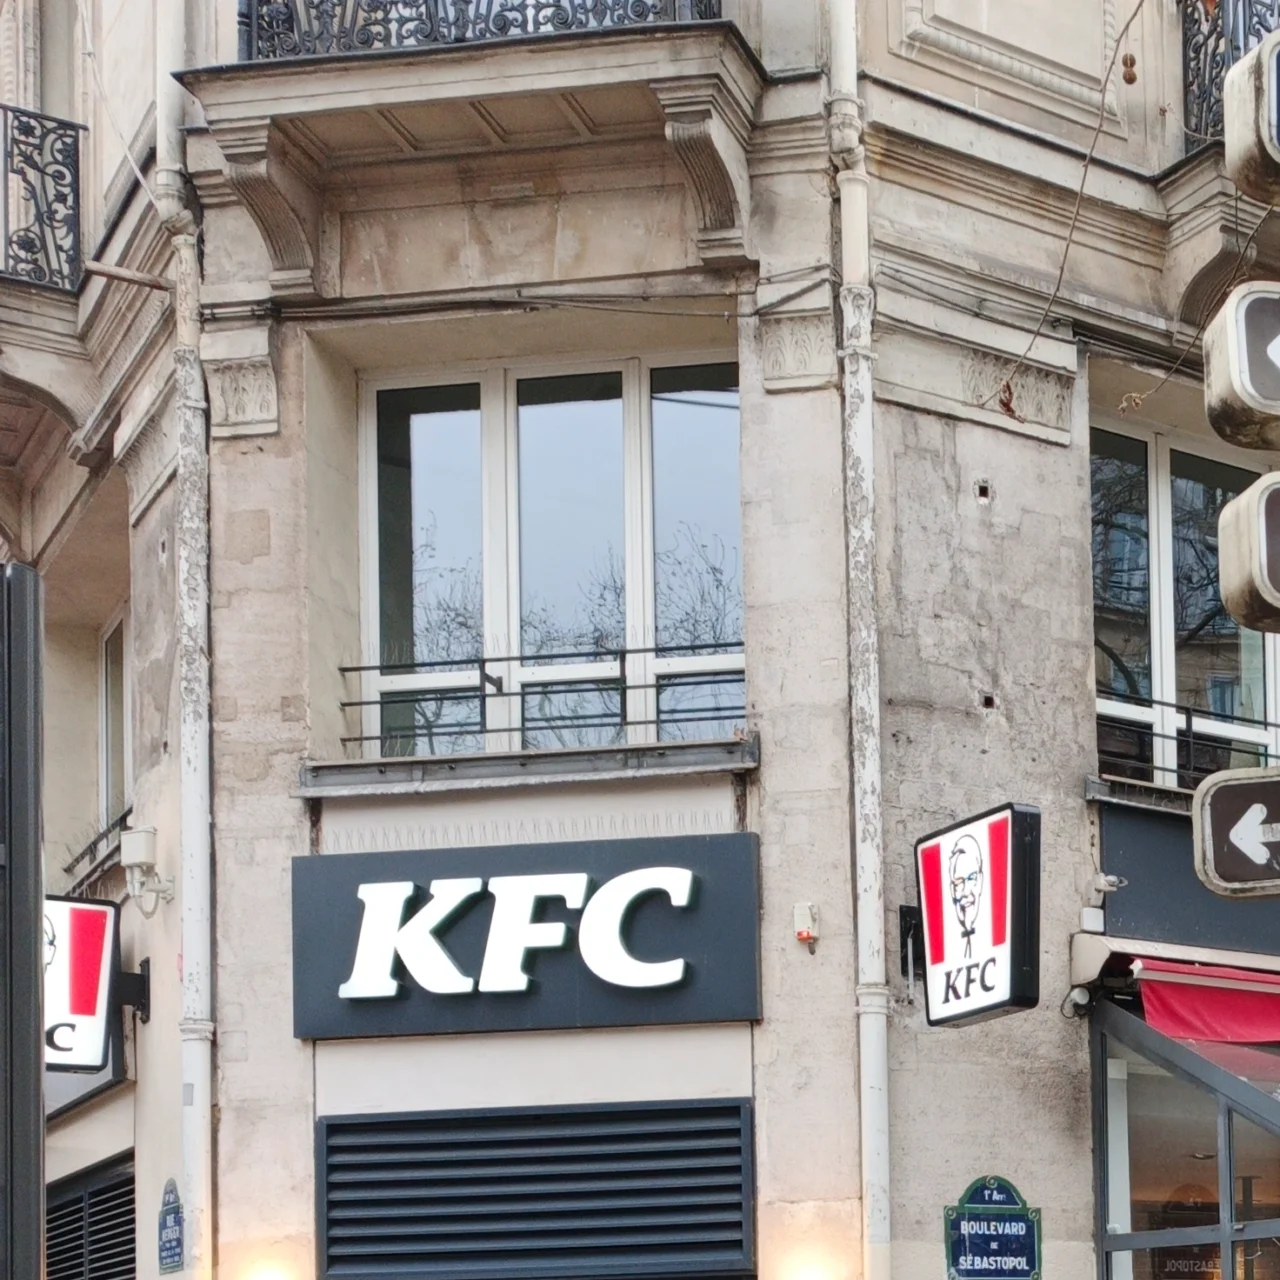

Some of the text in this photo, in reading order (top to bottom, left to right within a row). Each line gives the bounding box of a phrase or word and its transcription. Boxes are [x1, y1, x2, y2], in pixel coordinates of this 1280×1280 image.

[337, 866, 696, 1000] KFC
[942, 957, 997, 1005] KFC
[960, 1220, 1027, 1236] BOULEVARD
[958, 1253, 1030, 1270] SÉBASTOPOL
